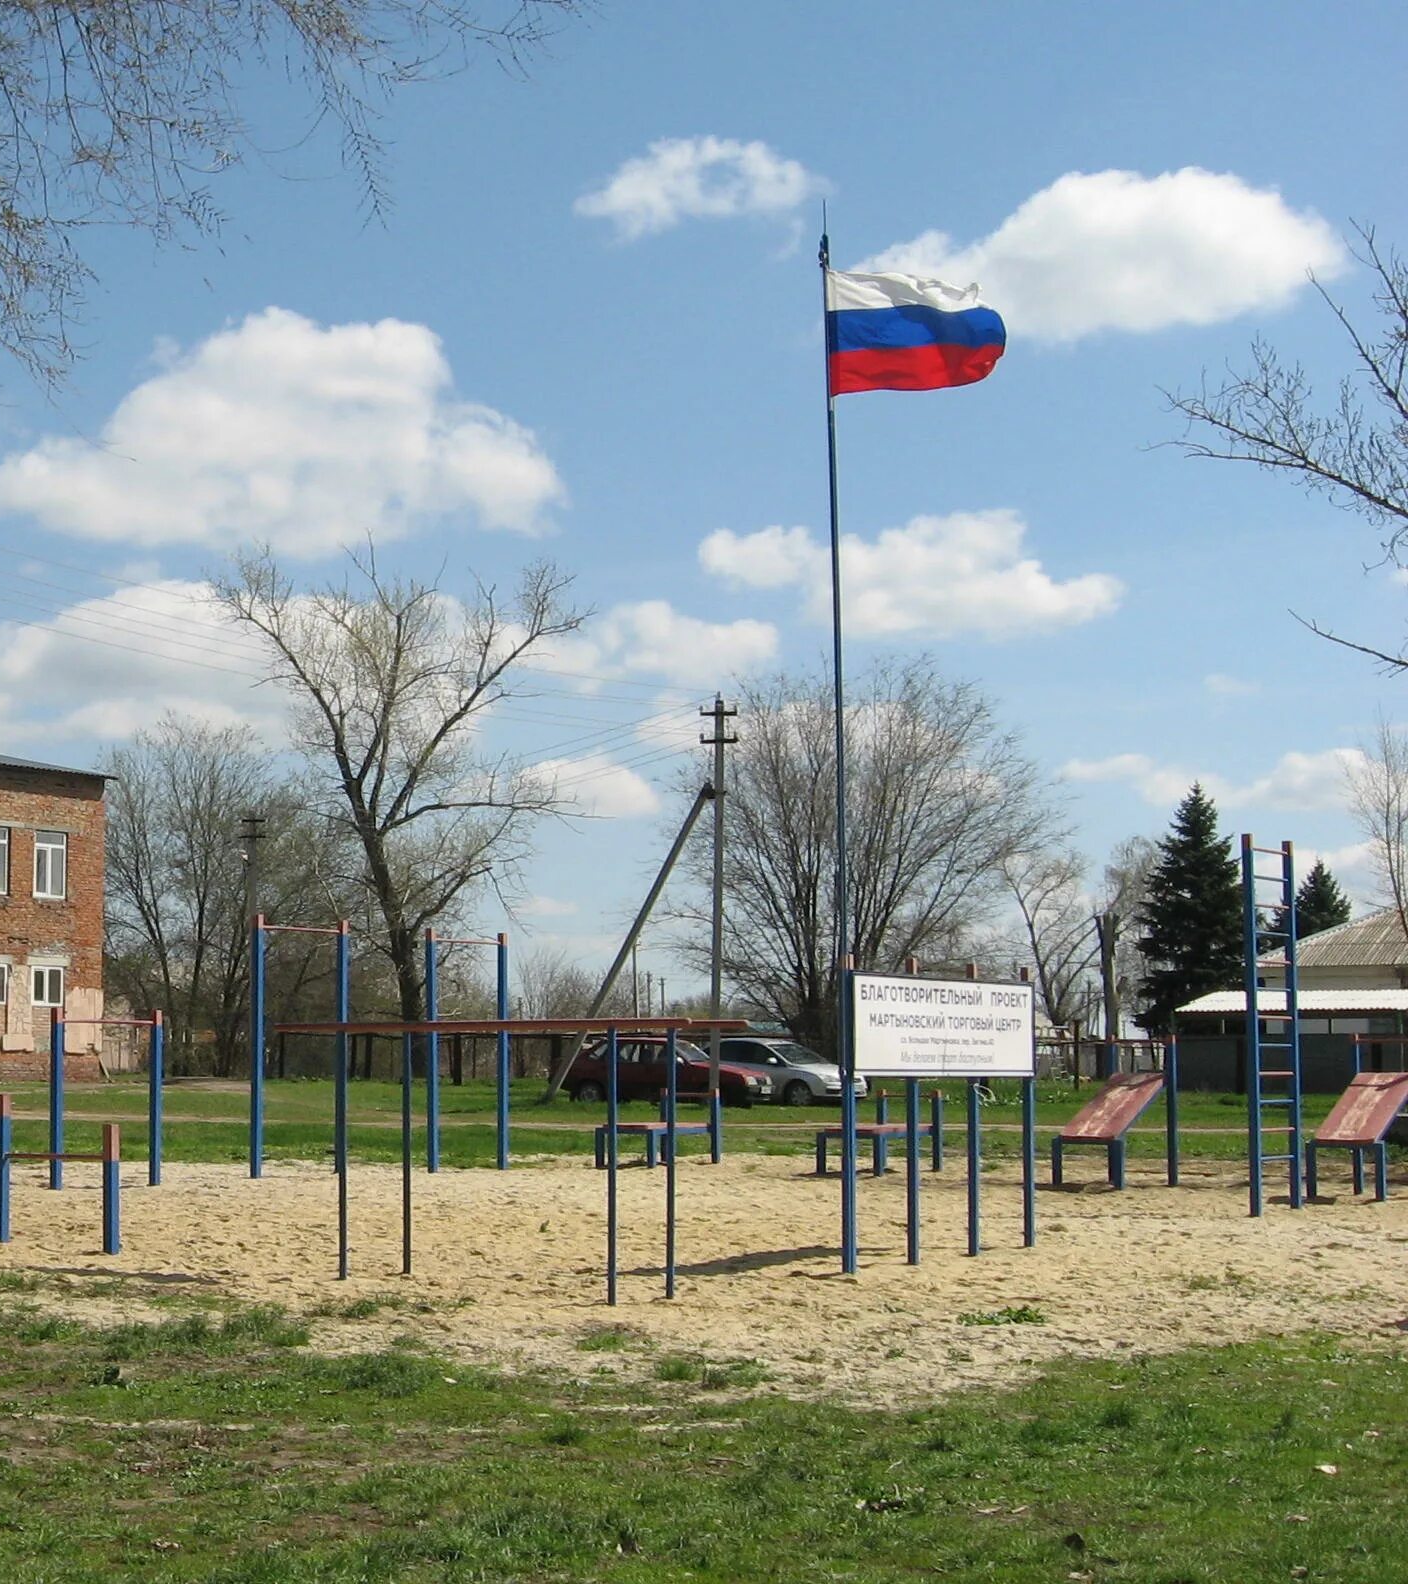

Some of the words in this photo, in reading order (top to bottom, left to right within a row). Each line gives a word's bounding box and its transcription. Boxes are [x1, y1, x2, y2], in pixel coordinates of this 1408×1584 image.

[860, 984, 983, 1006] БЛАГОТВОРИТЕЛЬНЫЙ
[990, 991, 1028, 1008] ПРОЕКТ
[869, 1011, 945, 1030] МАРТЫНОВСКИЙ
[948, 1013, 993, 1031] ТОРГОВЫЙ
[995, 1017, 1022, 1032] ЦЕНТР
